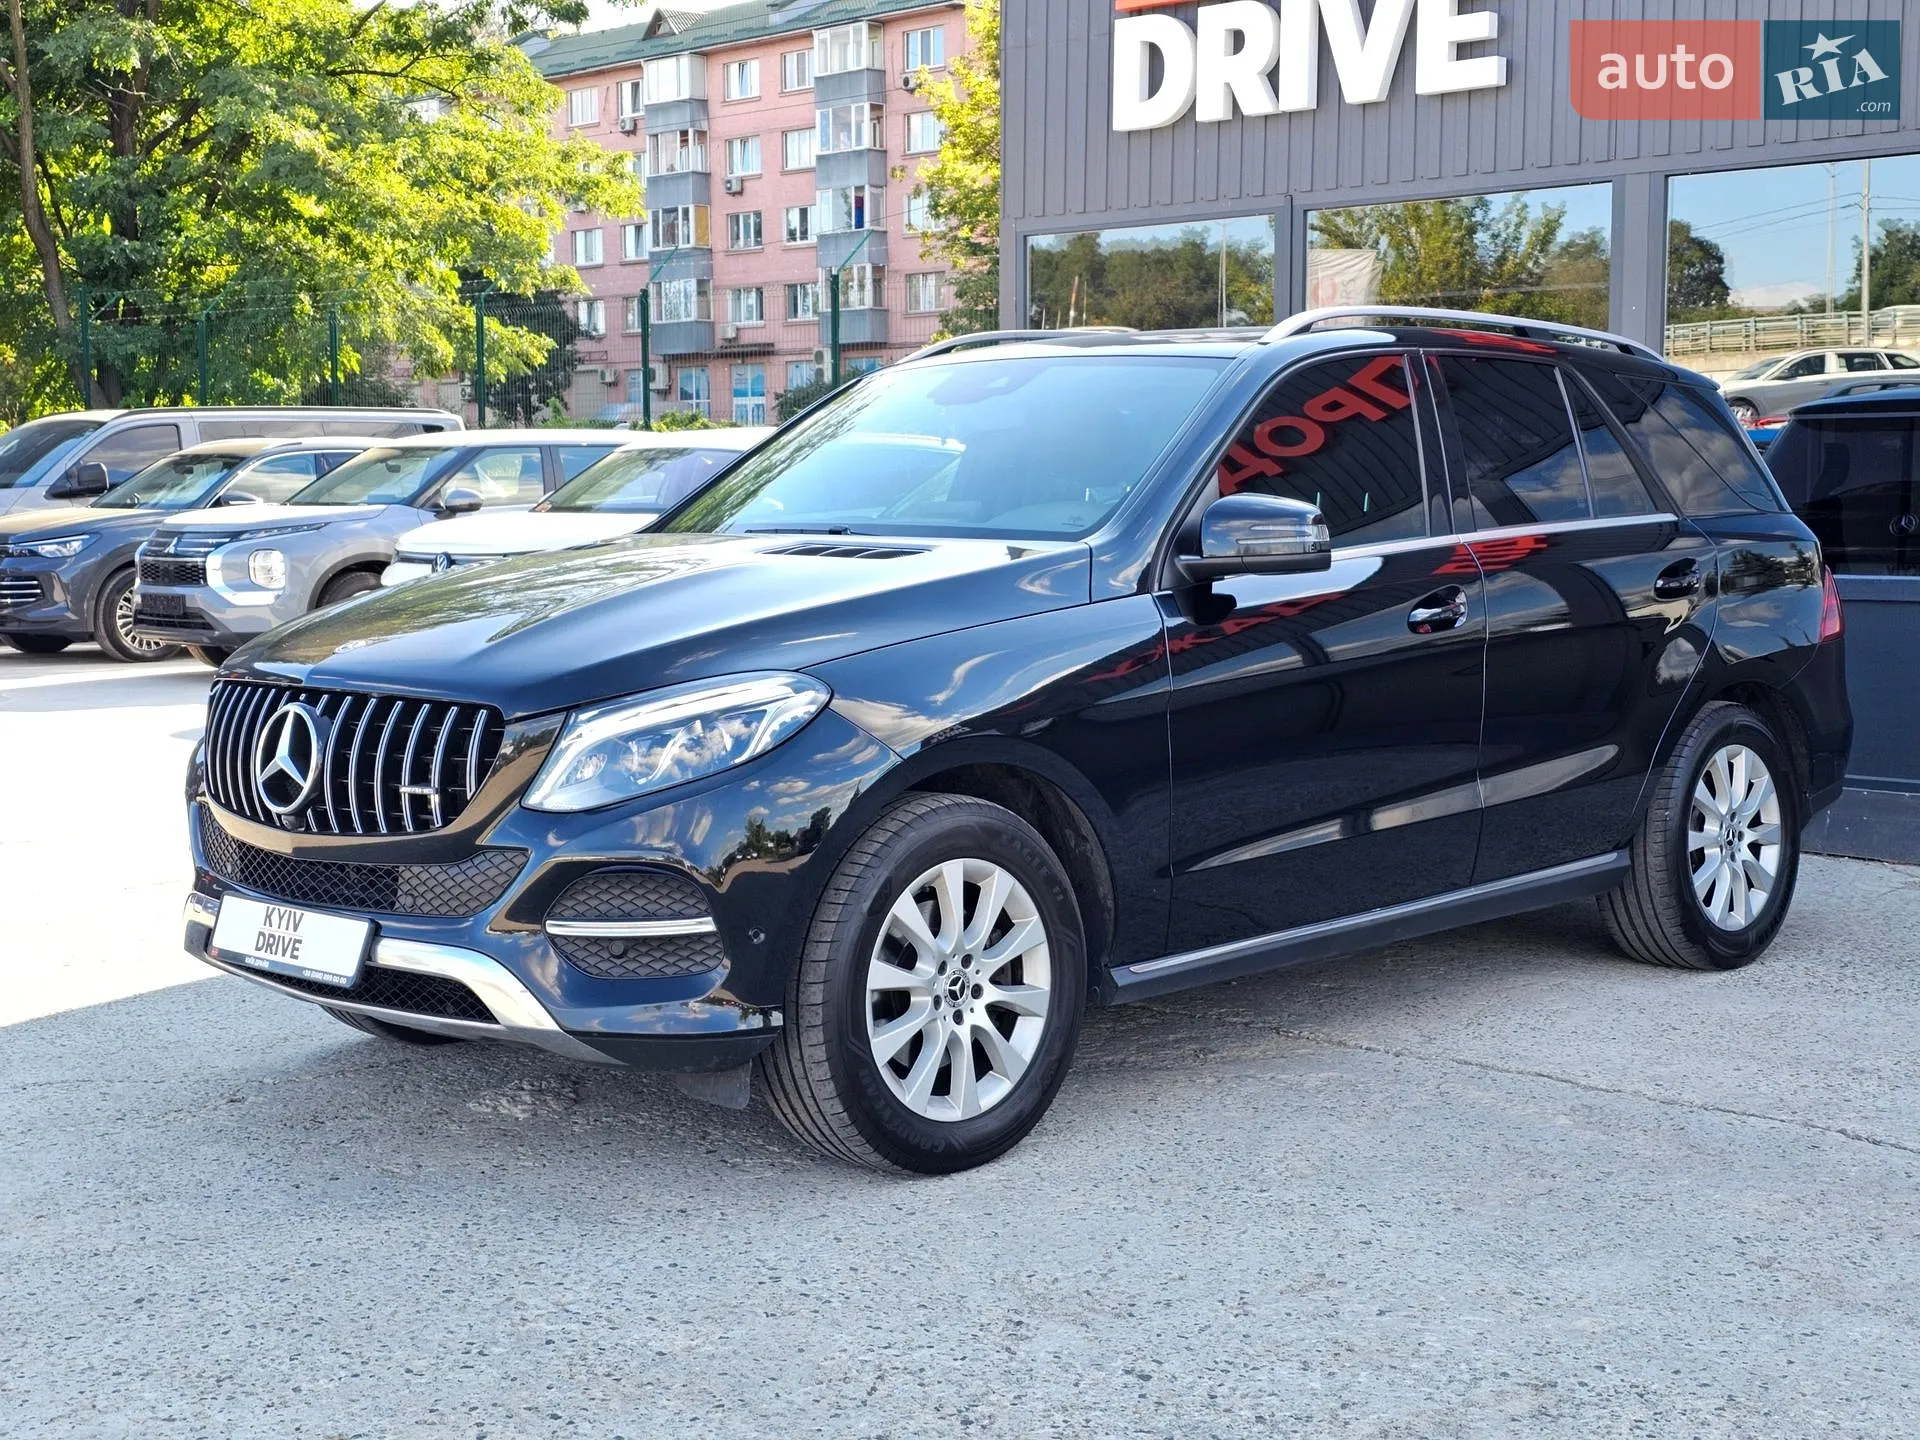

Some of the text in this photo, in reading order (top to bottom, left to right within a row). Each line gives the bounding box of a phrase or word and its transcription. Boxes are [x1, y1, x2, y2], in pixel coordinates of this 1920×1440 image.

[1113, 0, 1507, 132] DRIVE
[264, 906, 304, 932] KYIV
[255, 931, 303, 960] DRIVE
